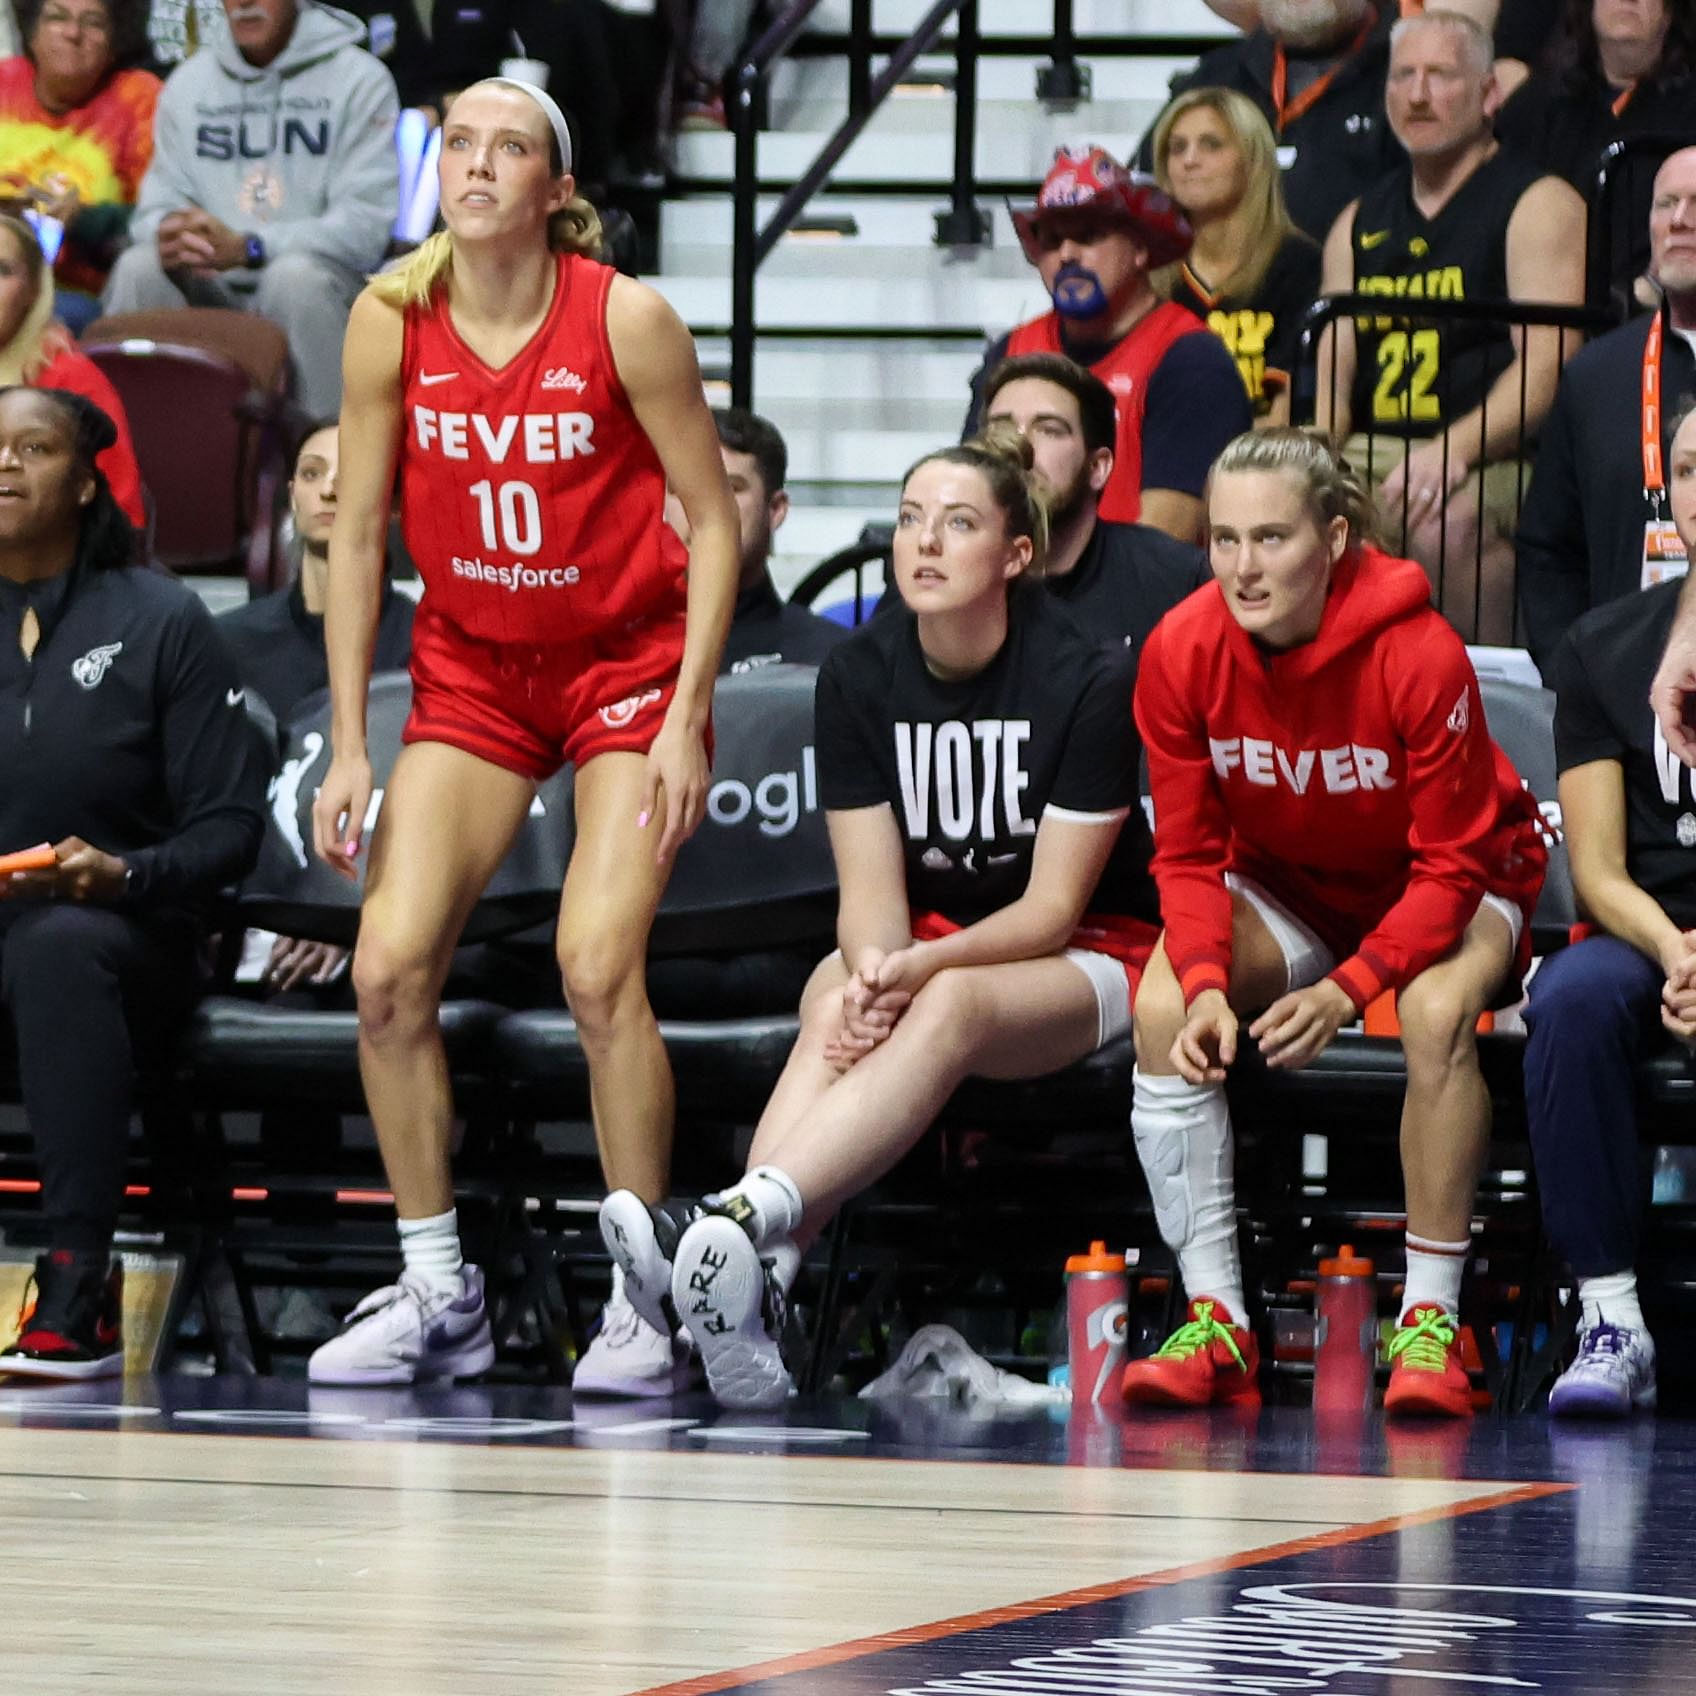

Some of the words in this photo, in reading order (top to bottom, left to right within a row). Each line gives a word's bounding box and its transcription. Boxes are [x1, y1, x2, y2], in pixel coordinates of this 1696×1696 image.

[196, 119, 330, 160] SUN
[541, 366, 588, 395] Lilly
[1373, 328, 1441, 422] 22
[414, 404, 596, 464] FEVER
[468, 478, 543, 556] 10
[451, 555, 581, 593] salesforce
[708, 745, 818, 837] ogl
[894, 719, 1035, 839] VOTE
[1209, 736, 1398, 795] FEVER
[690, 1245, 735, 1335] RARE
